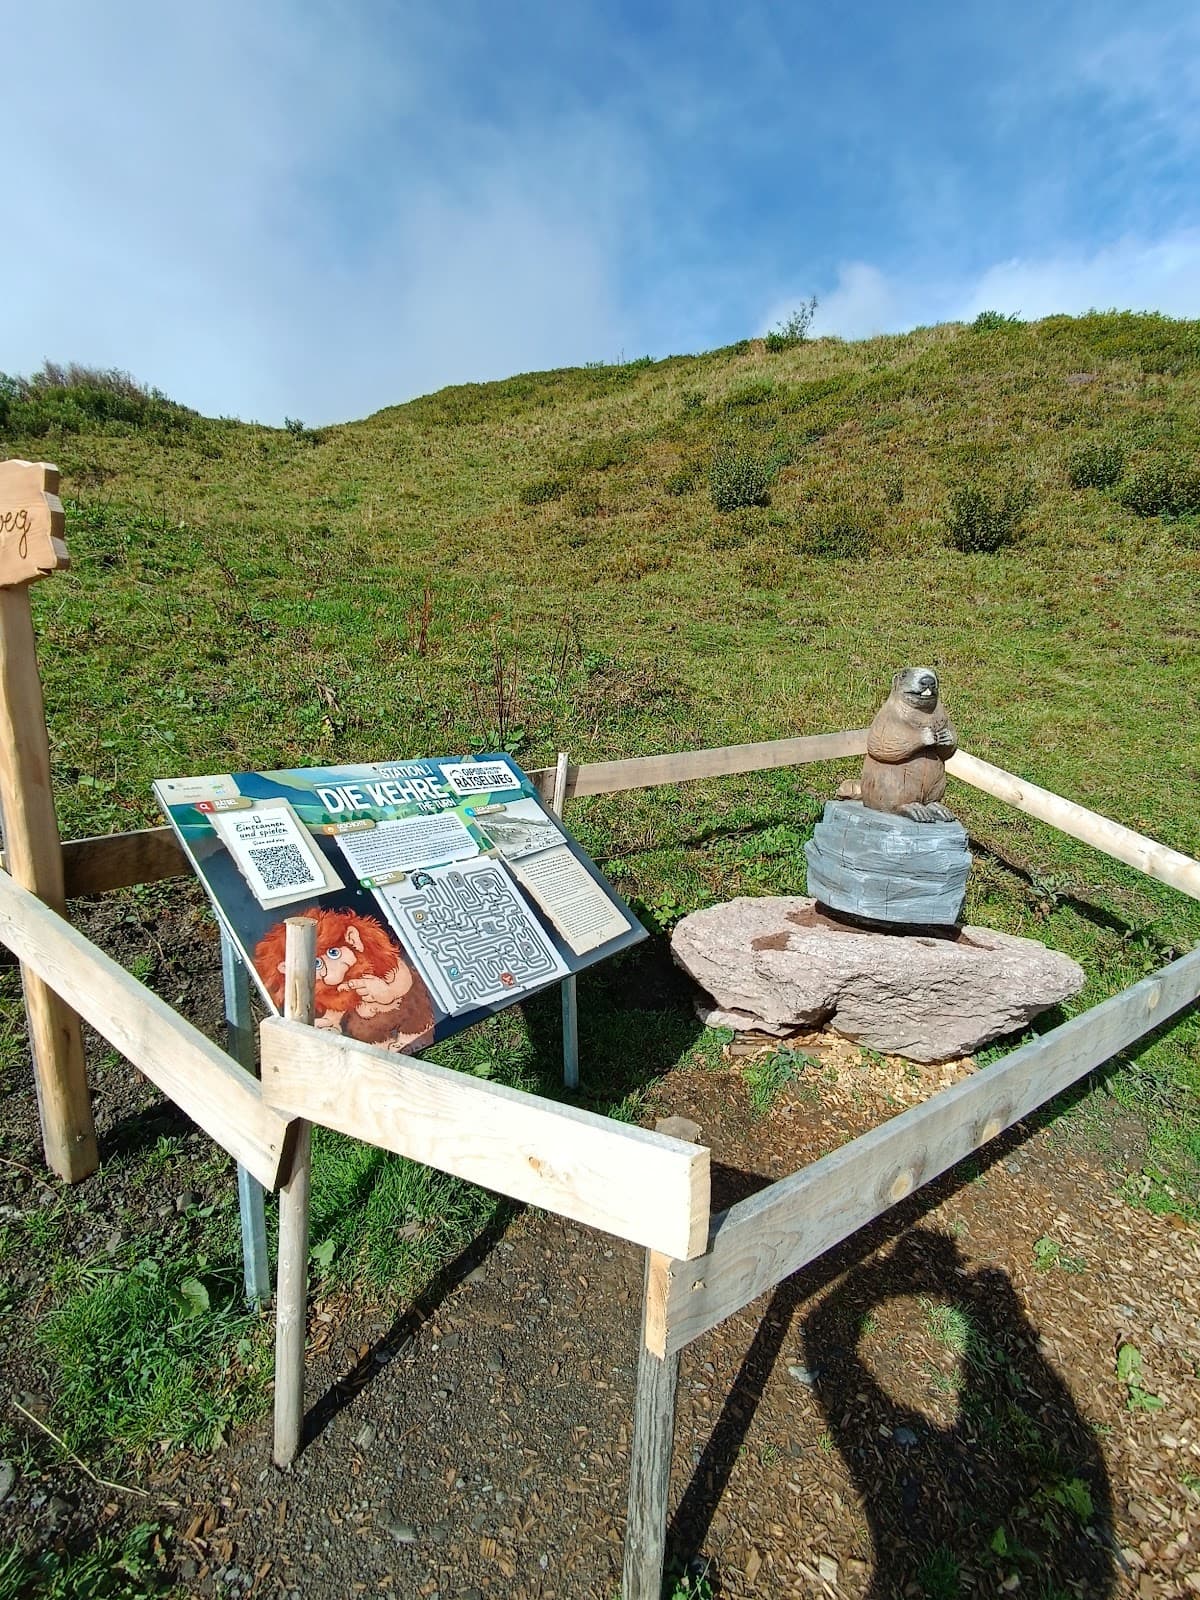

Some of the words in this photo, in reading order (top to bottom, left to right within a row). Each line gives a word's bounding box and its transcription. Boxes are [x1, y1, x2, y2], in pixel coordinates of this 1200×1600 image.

[378, 763, 427, 780] STATION
[453, 773, 513, 789] RÄTSELWEG
[316, 784, 372, 814] DIE
[365, 776, 450, 807] KEHRE
[417, 800, 437, 812] THE
[435, 798, 457, 810] TURN
[236, 822, 285, 832] Einscannen
[240, 830, 256, 839] und
[259, 828, 288, 838] spielen
